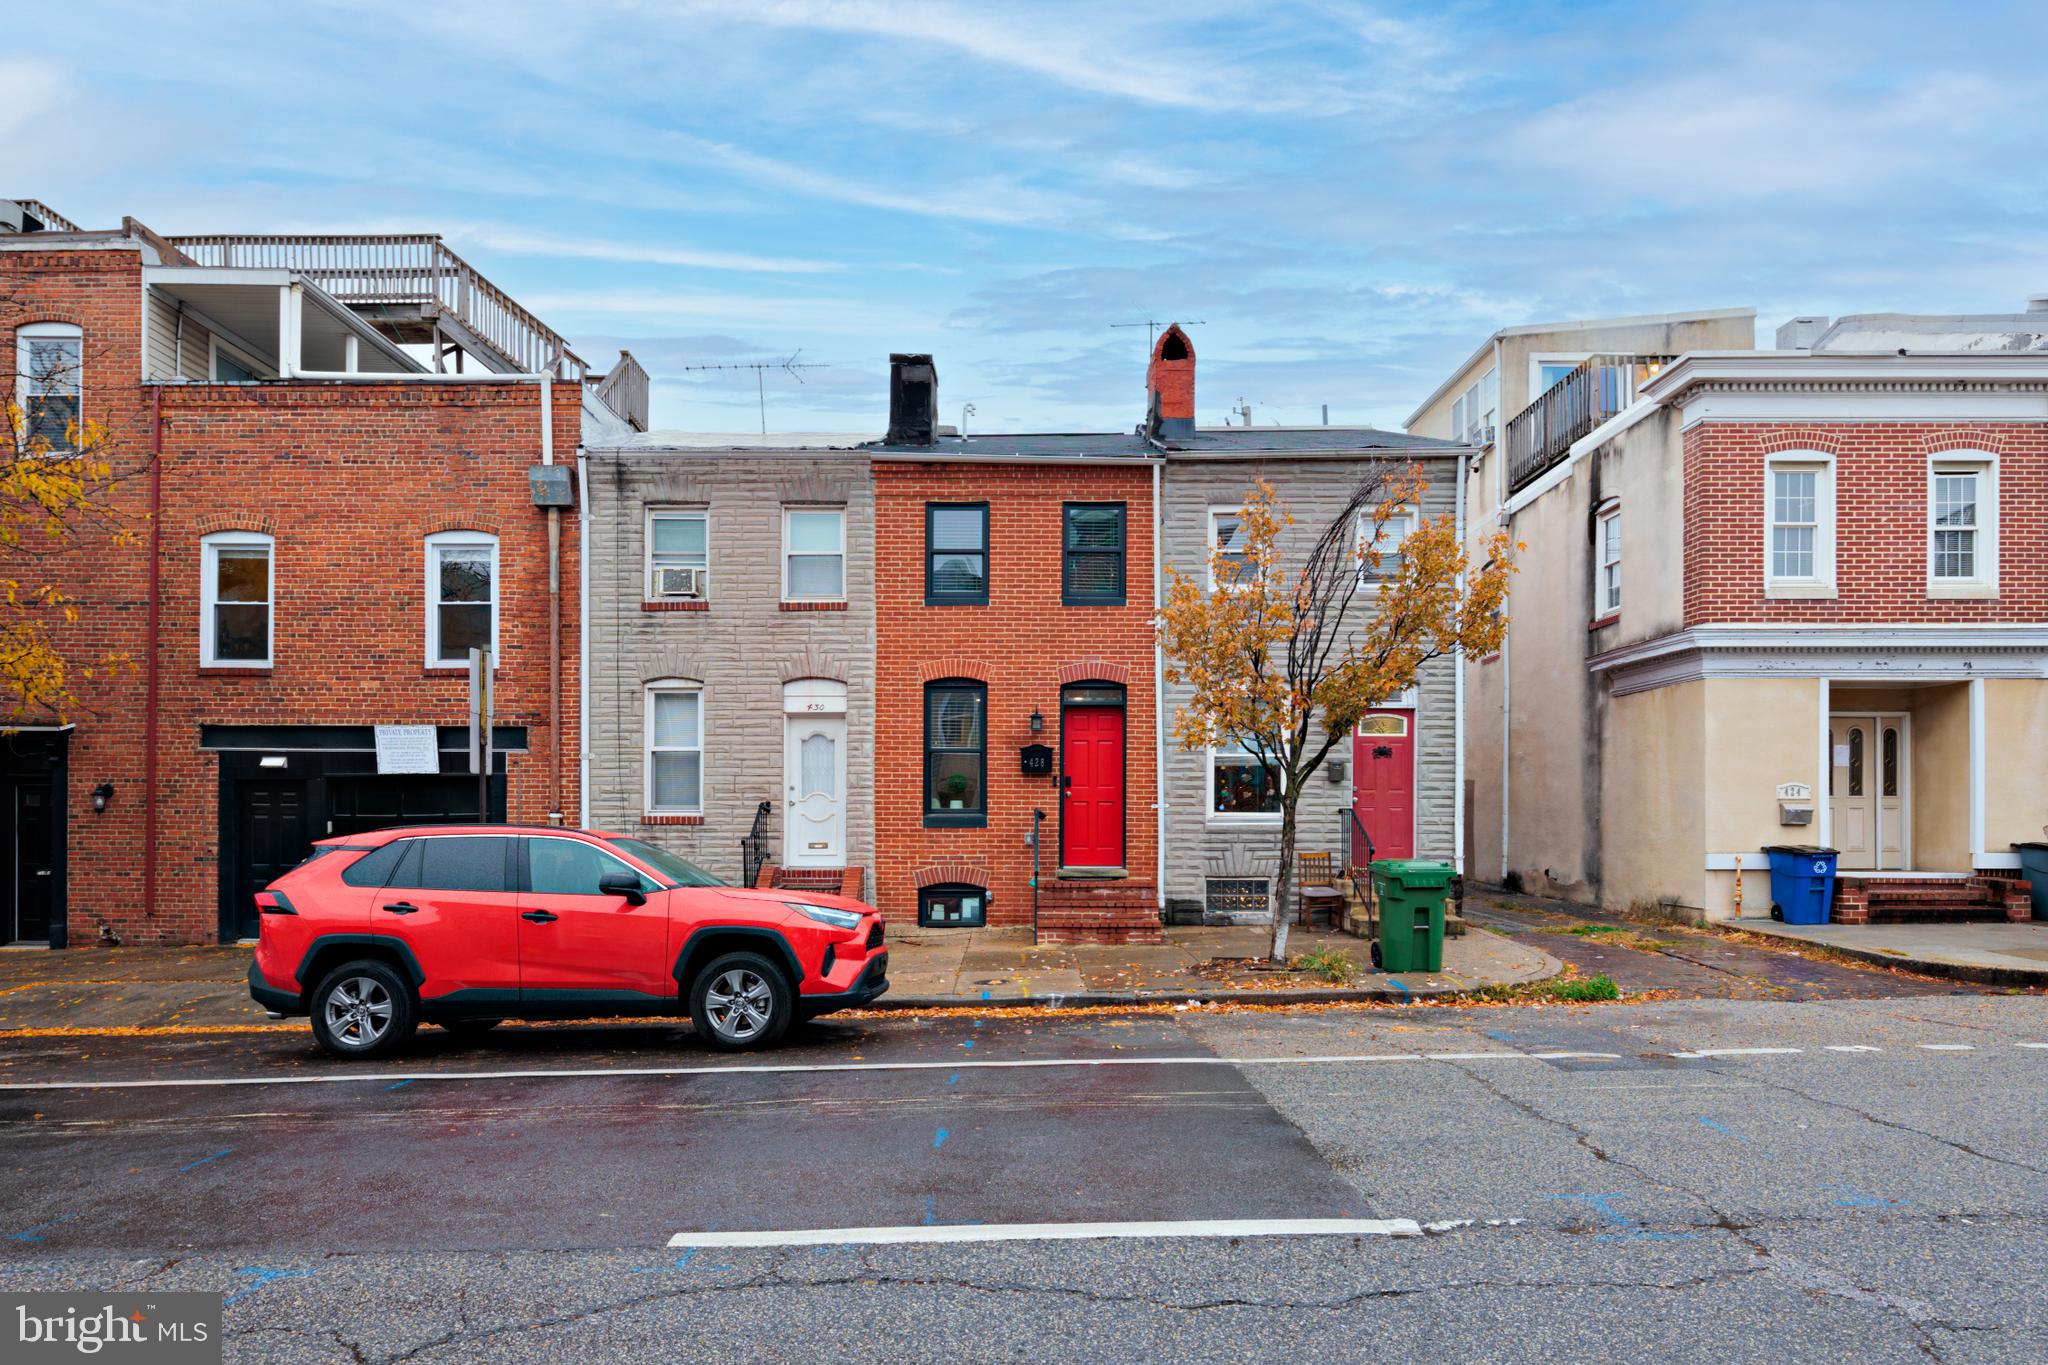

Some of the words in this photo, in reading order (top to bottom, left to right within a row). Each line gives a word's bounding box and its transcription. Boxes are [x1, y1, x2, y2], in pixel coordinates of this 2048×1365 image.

[807, 703, 824, 711] 430
[379, 728, 401, 736] PRIVATE
[403, 728, 431, 736] PROPERTY
[1029, 757, 1044, 768] 428
[1784, 786, 1800, 797] 424
